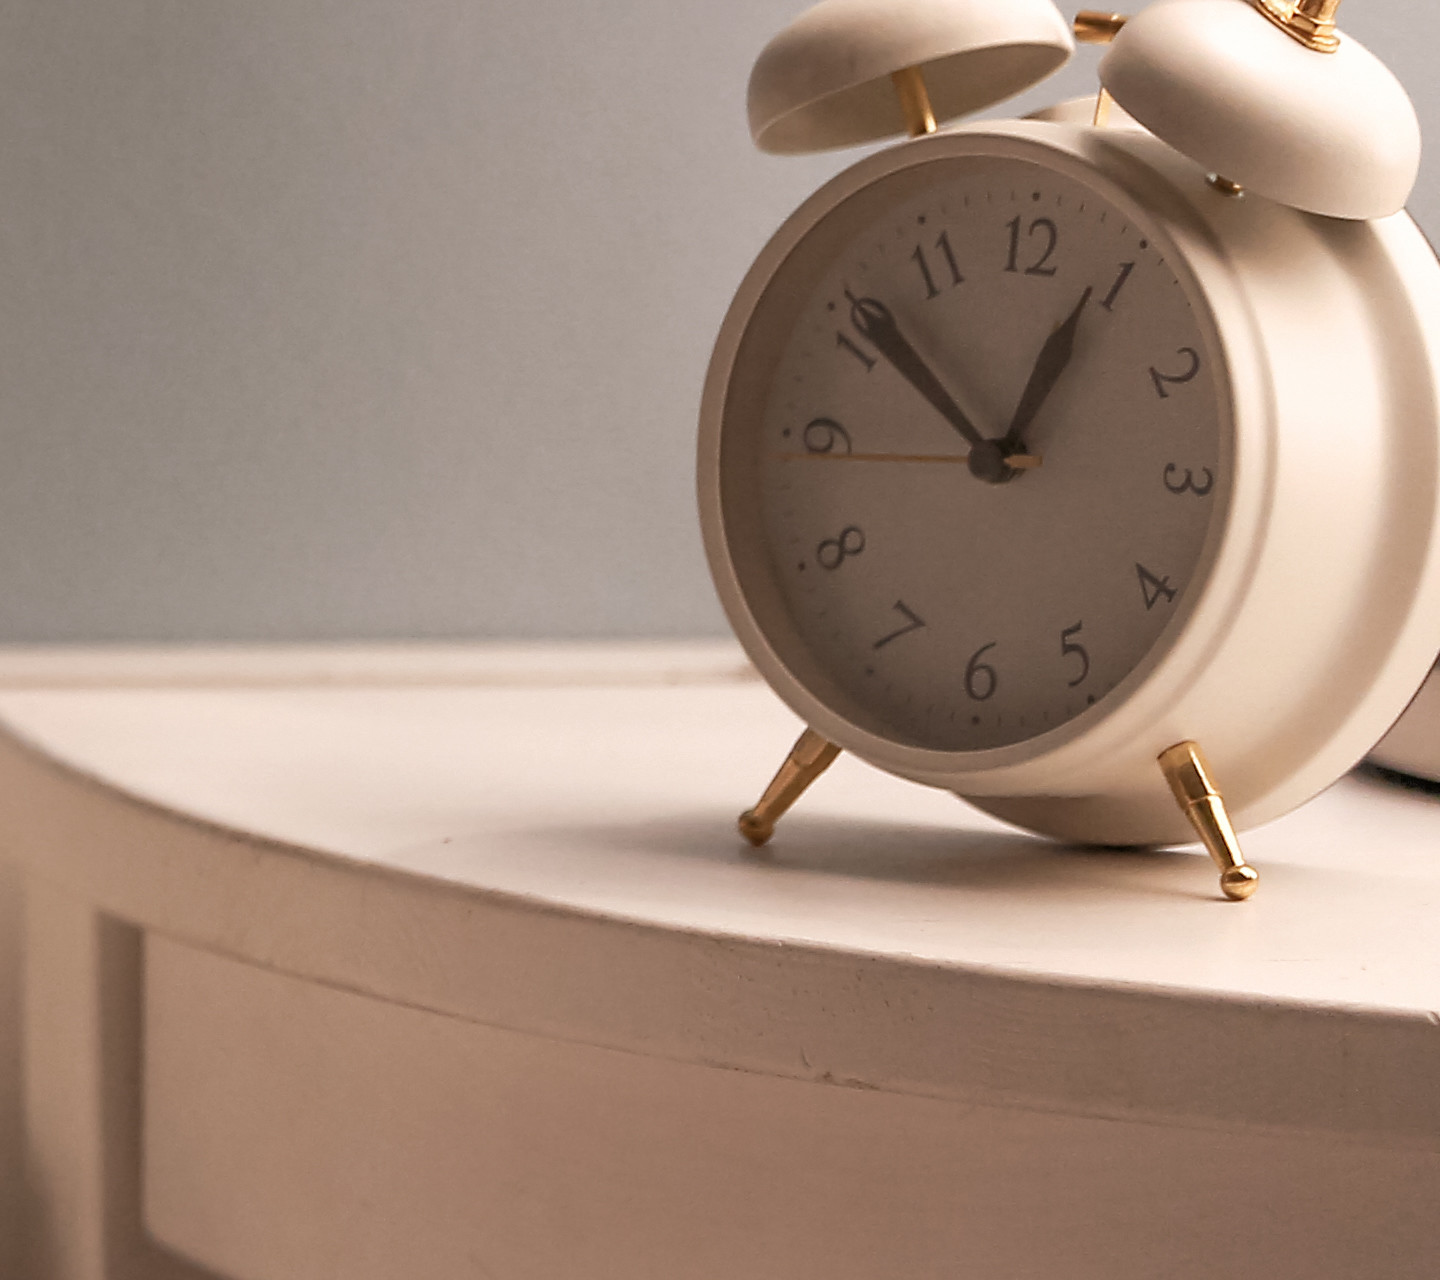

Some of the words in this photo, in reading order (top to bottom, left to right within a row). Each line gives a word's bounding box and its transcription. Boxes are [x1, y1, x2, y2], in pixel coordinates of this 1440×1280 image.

[909, 231, 966, 301] 11
[1004, 215, 1058, 277] 12
[1097, 260, 1136, 313] 1
[836, 296, 894, 373] 10
[1148, 346, 1200, 400] 2
[802, 417, 852, 457] 9
[1162, 462, 1213, 497] 3
[816, 525, 866, 571] 8
[1135, 562, 1178, 611] 4
[872, 599, 926, 651] 7
[964, 641, 998, 702] 6
[1060, 621, 1090, 687] 5
